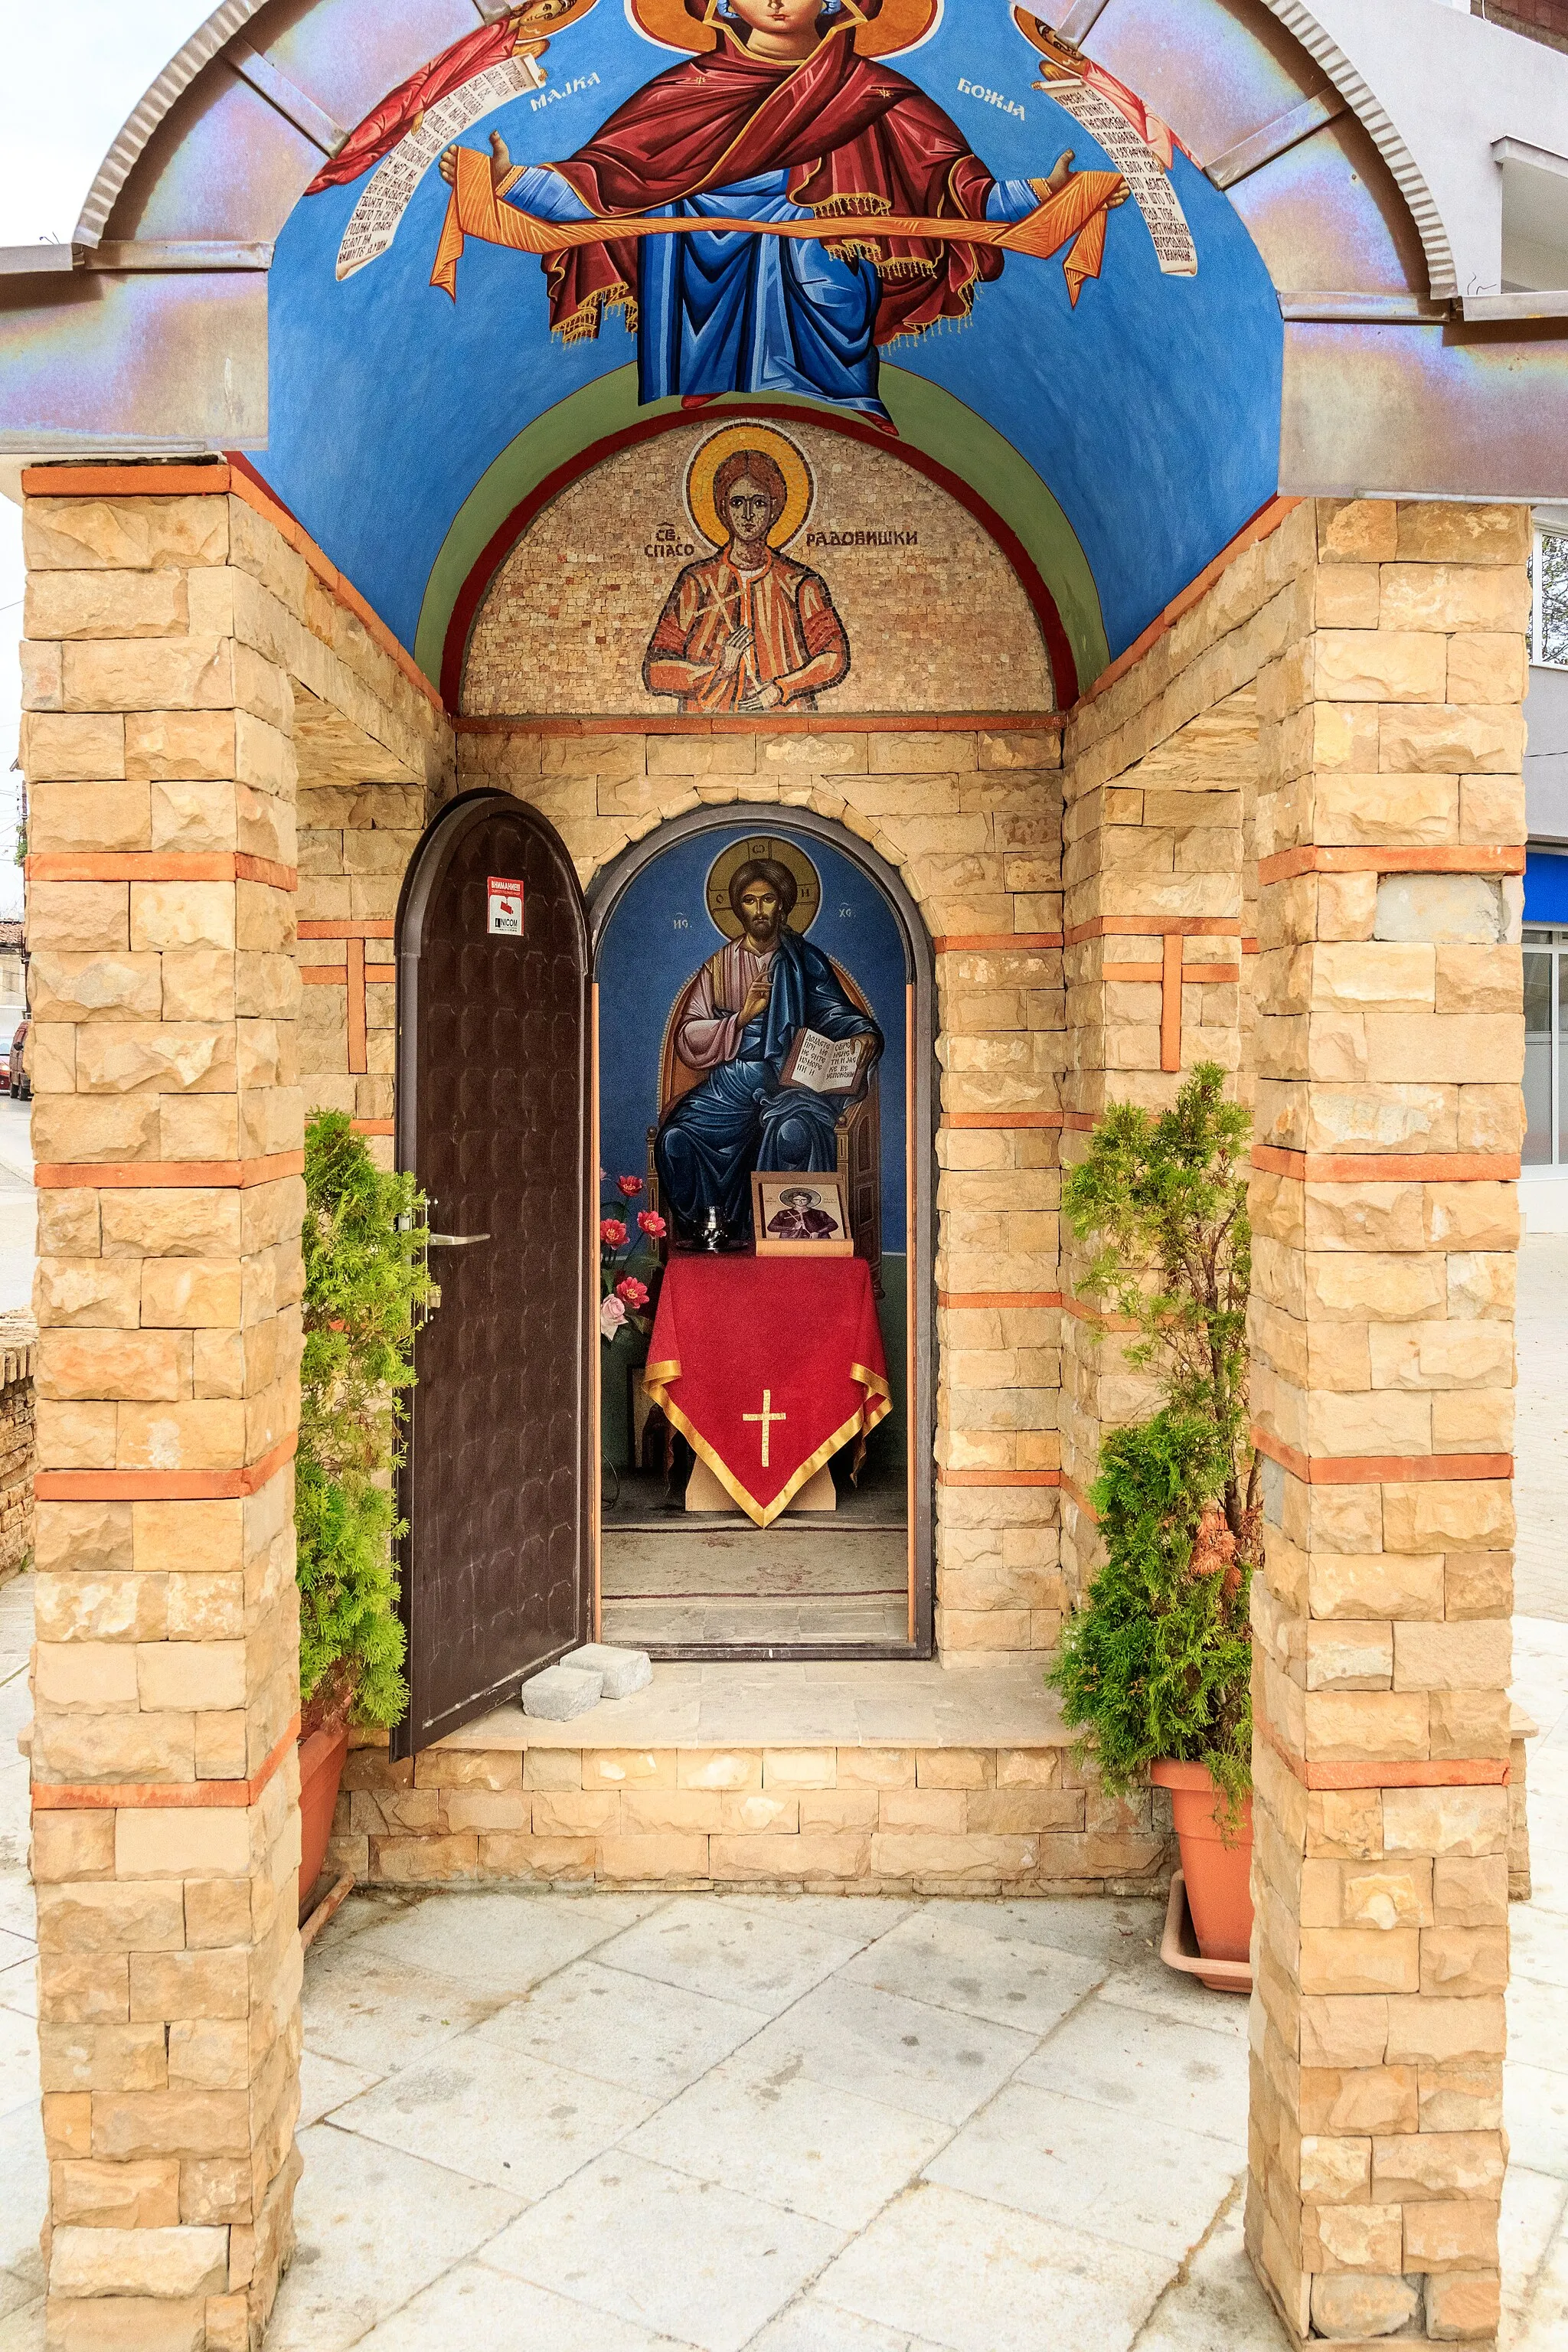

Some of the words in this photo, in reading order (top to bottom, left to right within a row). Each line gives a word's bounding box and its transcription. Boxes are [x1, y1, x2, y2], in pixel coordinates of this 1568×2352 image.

[531, 71, 601, 113] МАЈКА
[957, 78, 1026, 122] БОЖЈА
[644, 544, 694, 557] СПАСО
[806, 531, 918, 547] РАДОВИШКИ
